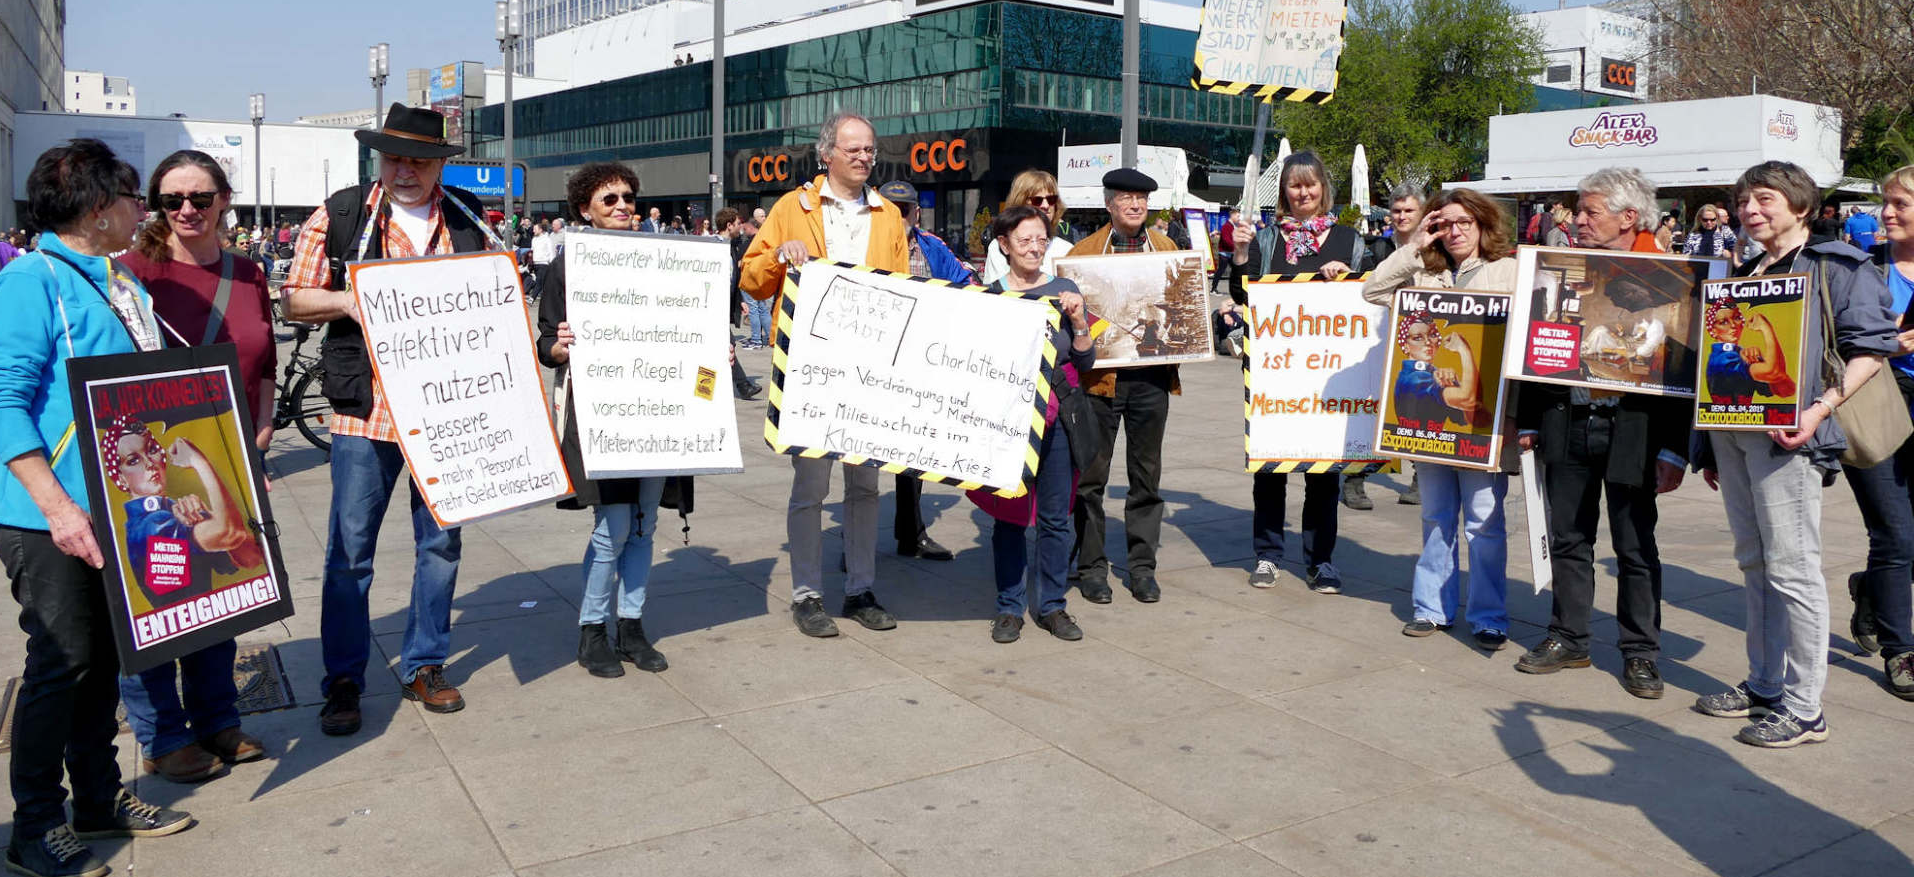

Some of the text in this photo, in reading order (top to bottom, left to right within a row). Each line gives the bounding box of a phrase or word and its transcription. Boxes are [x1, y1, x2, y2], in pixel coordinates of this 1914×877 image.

[1208, 13, 1258, 29] WERK
[1271, 11, 1340, 28] MIETEN-
[1203, 31, 1256, 51] STADT
[1608, 63, 1635, 86] CCC
[1594, 115, 1641, 130] ALEX
[749, 154, 788, 183] CCC
[911, 138, 966, 173] CCC
[477, 168, 490, 183] U
[574, 242, 722, 274] Preiswerter Wohnraum
[363, 275, 515, 325] Milieuschutz
[572, 290, 598, 304] muss
[601, 288, 648, 306] erhalten
[833, 284, 903, 312] MIETER
[1707, 278, 1803, 299] We Can Do It!
[1402, 292, 1509, 317] We Can Do It!
[581, 320, 703, 346] Spekulantentum
[826, 311, 886, 342] STADT
[1251, 304, 1368, 339] Wohnen
[376, 326, 494, 370] effektiver
[1262, 348, 1342, 370] ist ein
[421, 352, 514, 405] nutzen!
[587, 358, 623, 378] einen
[632, 357, 684, 382] Riegel
[925, 342, 1036, 403] Charlottenburg
[856, 366, 944, 414] Verdrängung
[950, 391, 970, 407] und
[592, 396, 685, 416] vorschieben
[1250, 392, 1379, 416] Menschenrec
[423, 412, 489, 441] bessere
[835, 403, 937, 438] Milieuschutz
[947, 432, 969, 443] im
[1396, 427, 1413, 436] DEMO
[430, 428, 513, 462] Satzungen
[442, 464, 474, 485] mehr
[436, 471, 560, 512] mehr Geld einsetzen
[136, 576, 275, 644] ENTEIGNUNG!
